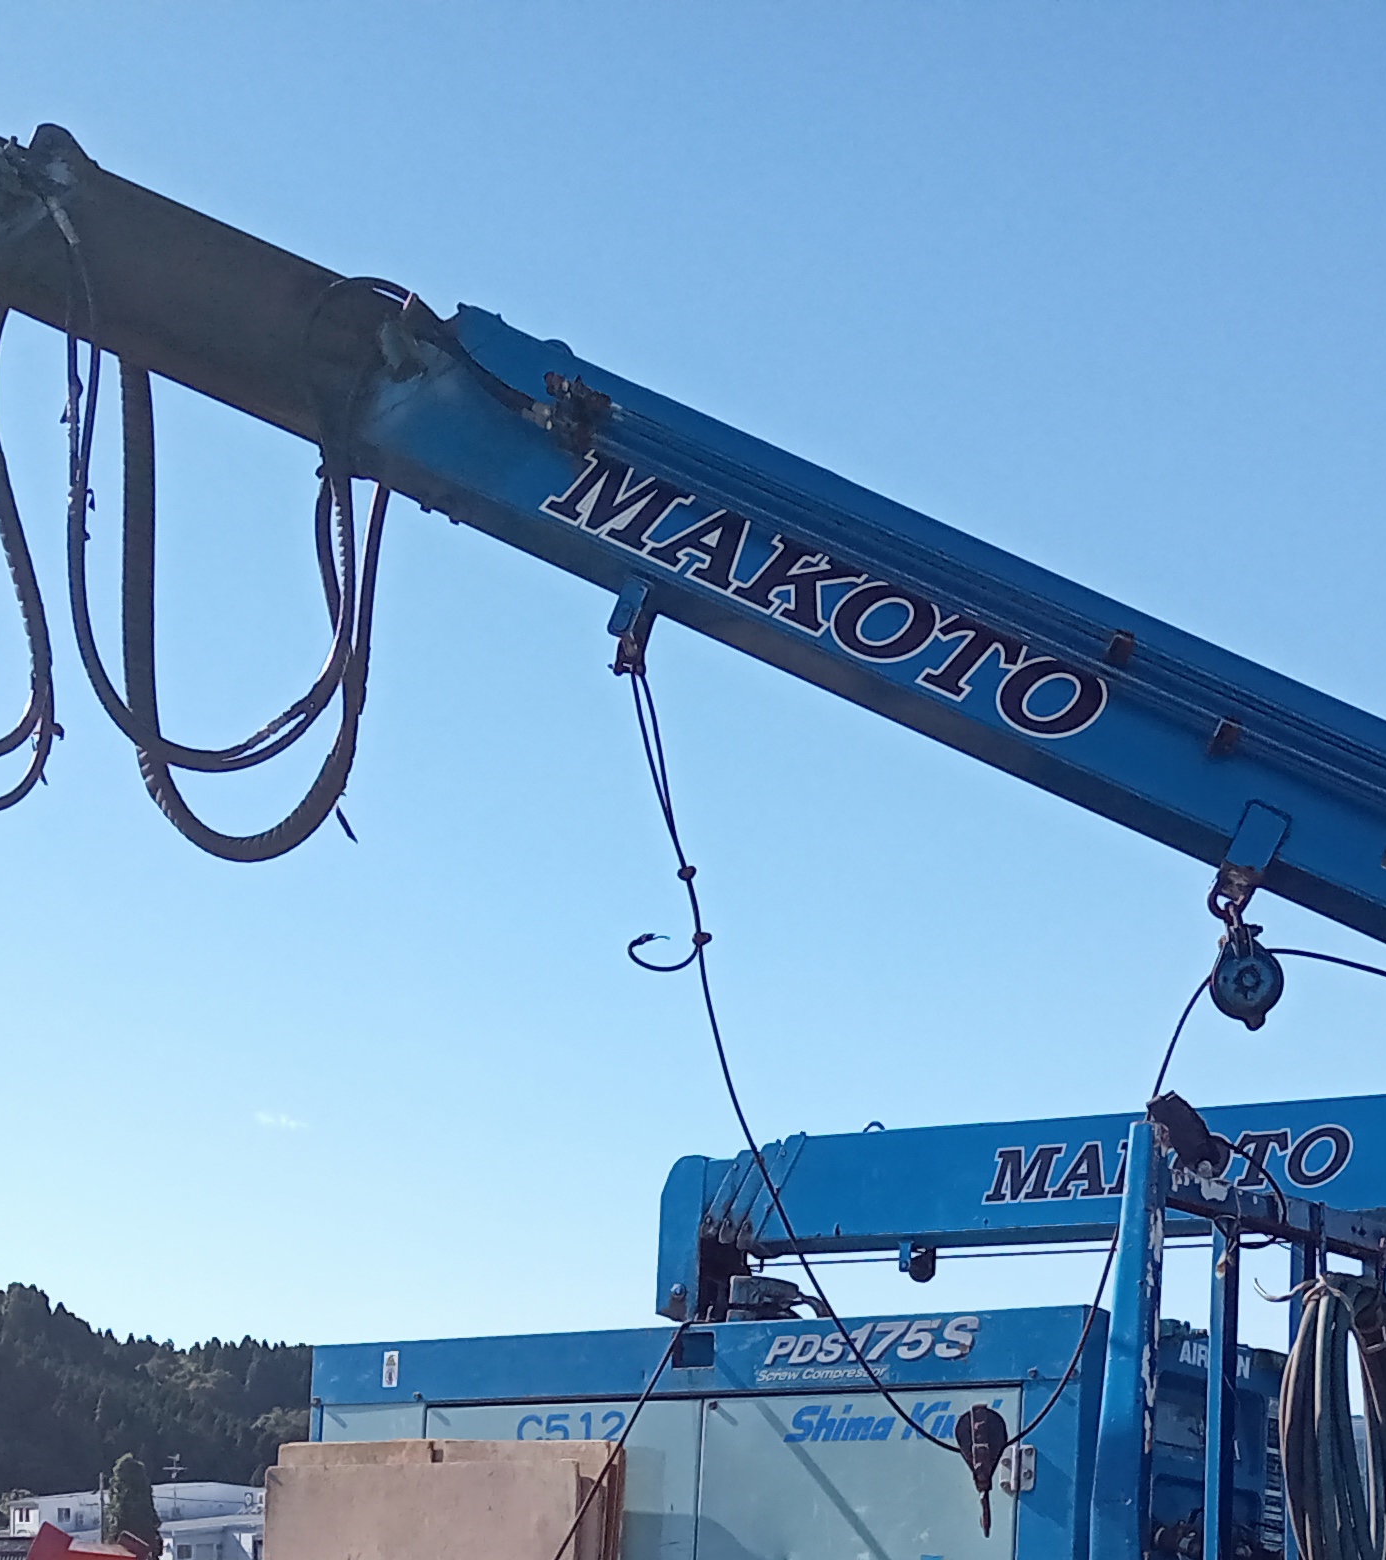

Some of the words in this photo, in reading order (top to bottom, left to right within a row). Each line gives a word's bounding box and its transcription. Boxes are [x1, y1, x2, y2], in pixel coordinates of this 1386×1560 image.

[539, 448, 1108, 739] MAKOTO
[981, 1123, 1354, 1206] MATO
[756, 1369, 801, 1383] Screw
[1178, 1340, 1252, 1380] AIRN
[783, 1403, 897, 1443] Shima
